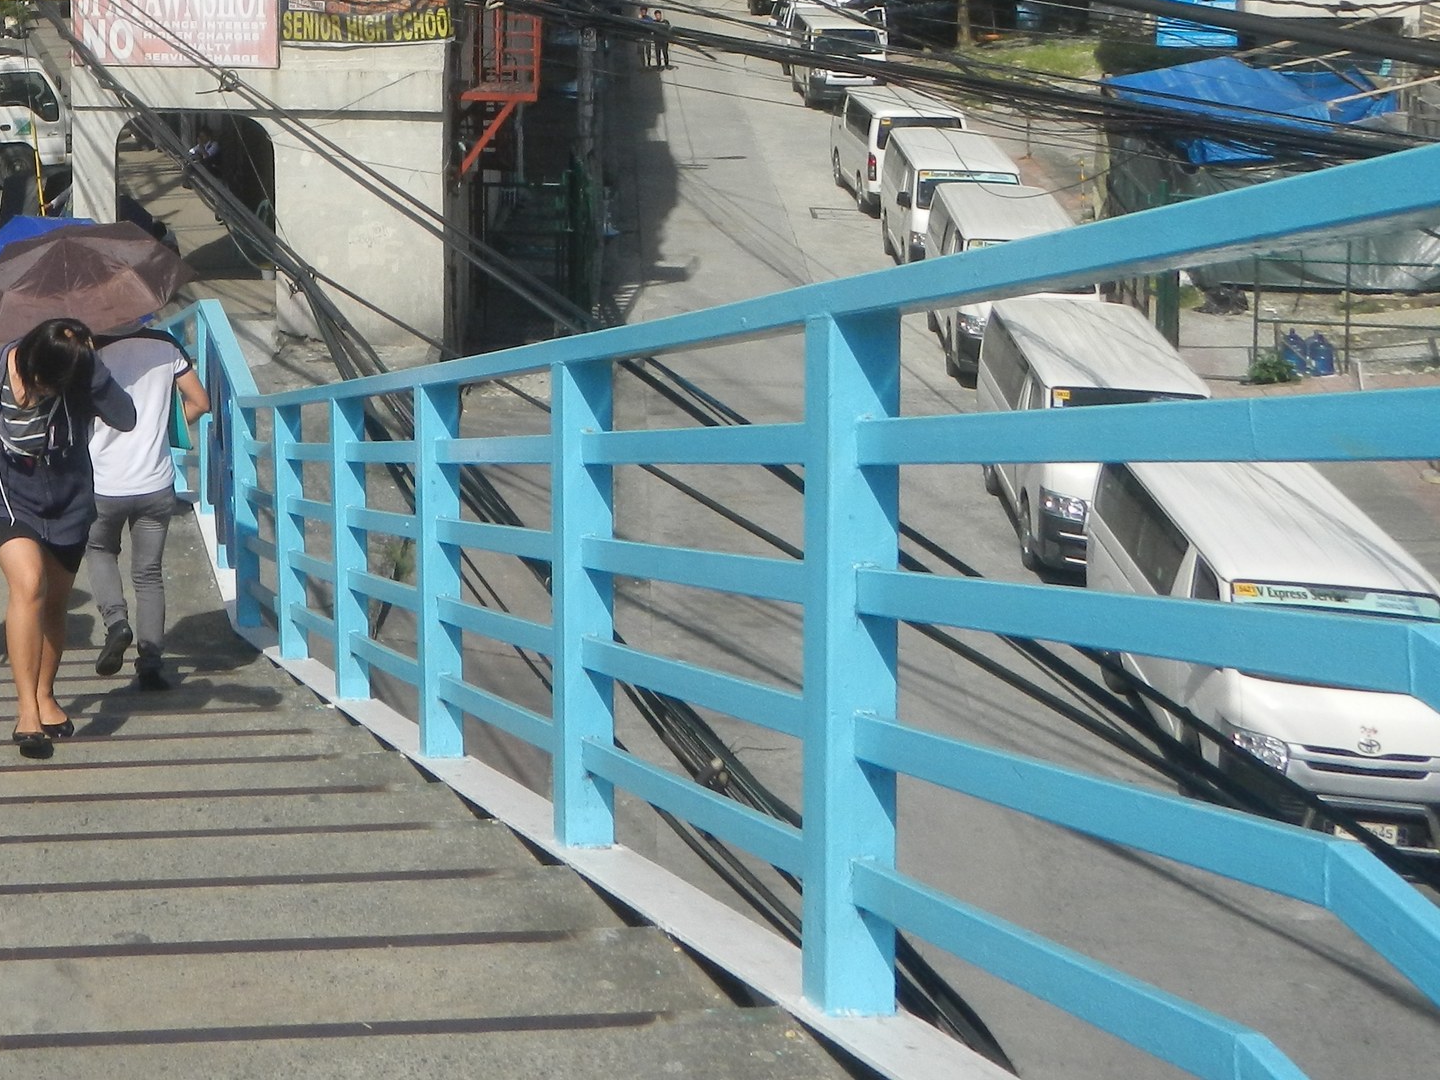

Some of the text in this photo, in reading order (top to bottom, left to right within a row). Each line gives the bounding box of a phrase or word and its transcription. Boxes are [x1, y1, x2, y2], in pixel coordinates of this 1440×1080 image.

[202, 21, 267, 31] INTEREST
[282, 7, 455, 42] SENIOR HIGH SCHOOL
[83, 18, 135, 60] NO
[196, 31, 260, 41] CHARGES
[1266, 587, 1309, 602] Express
[1310, 589, 1350, 604] Service
